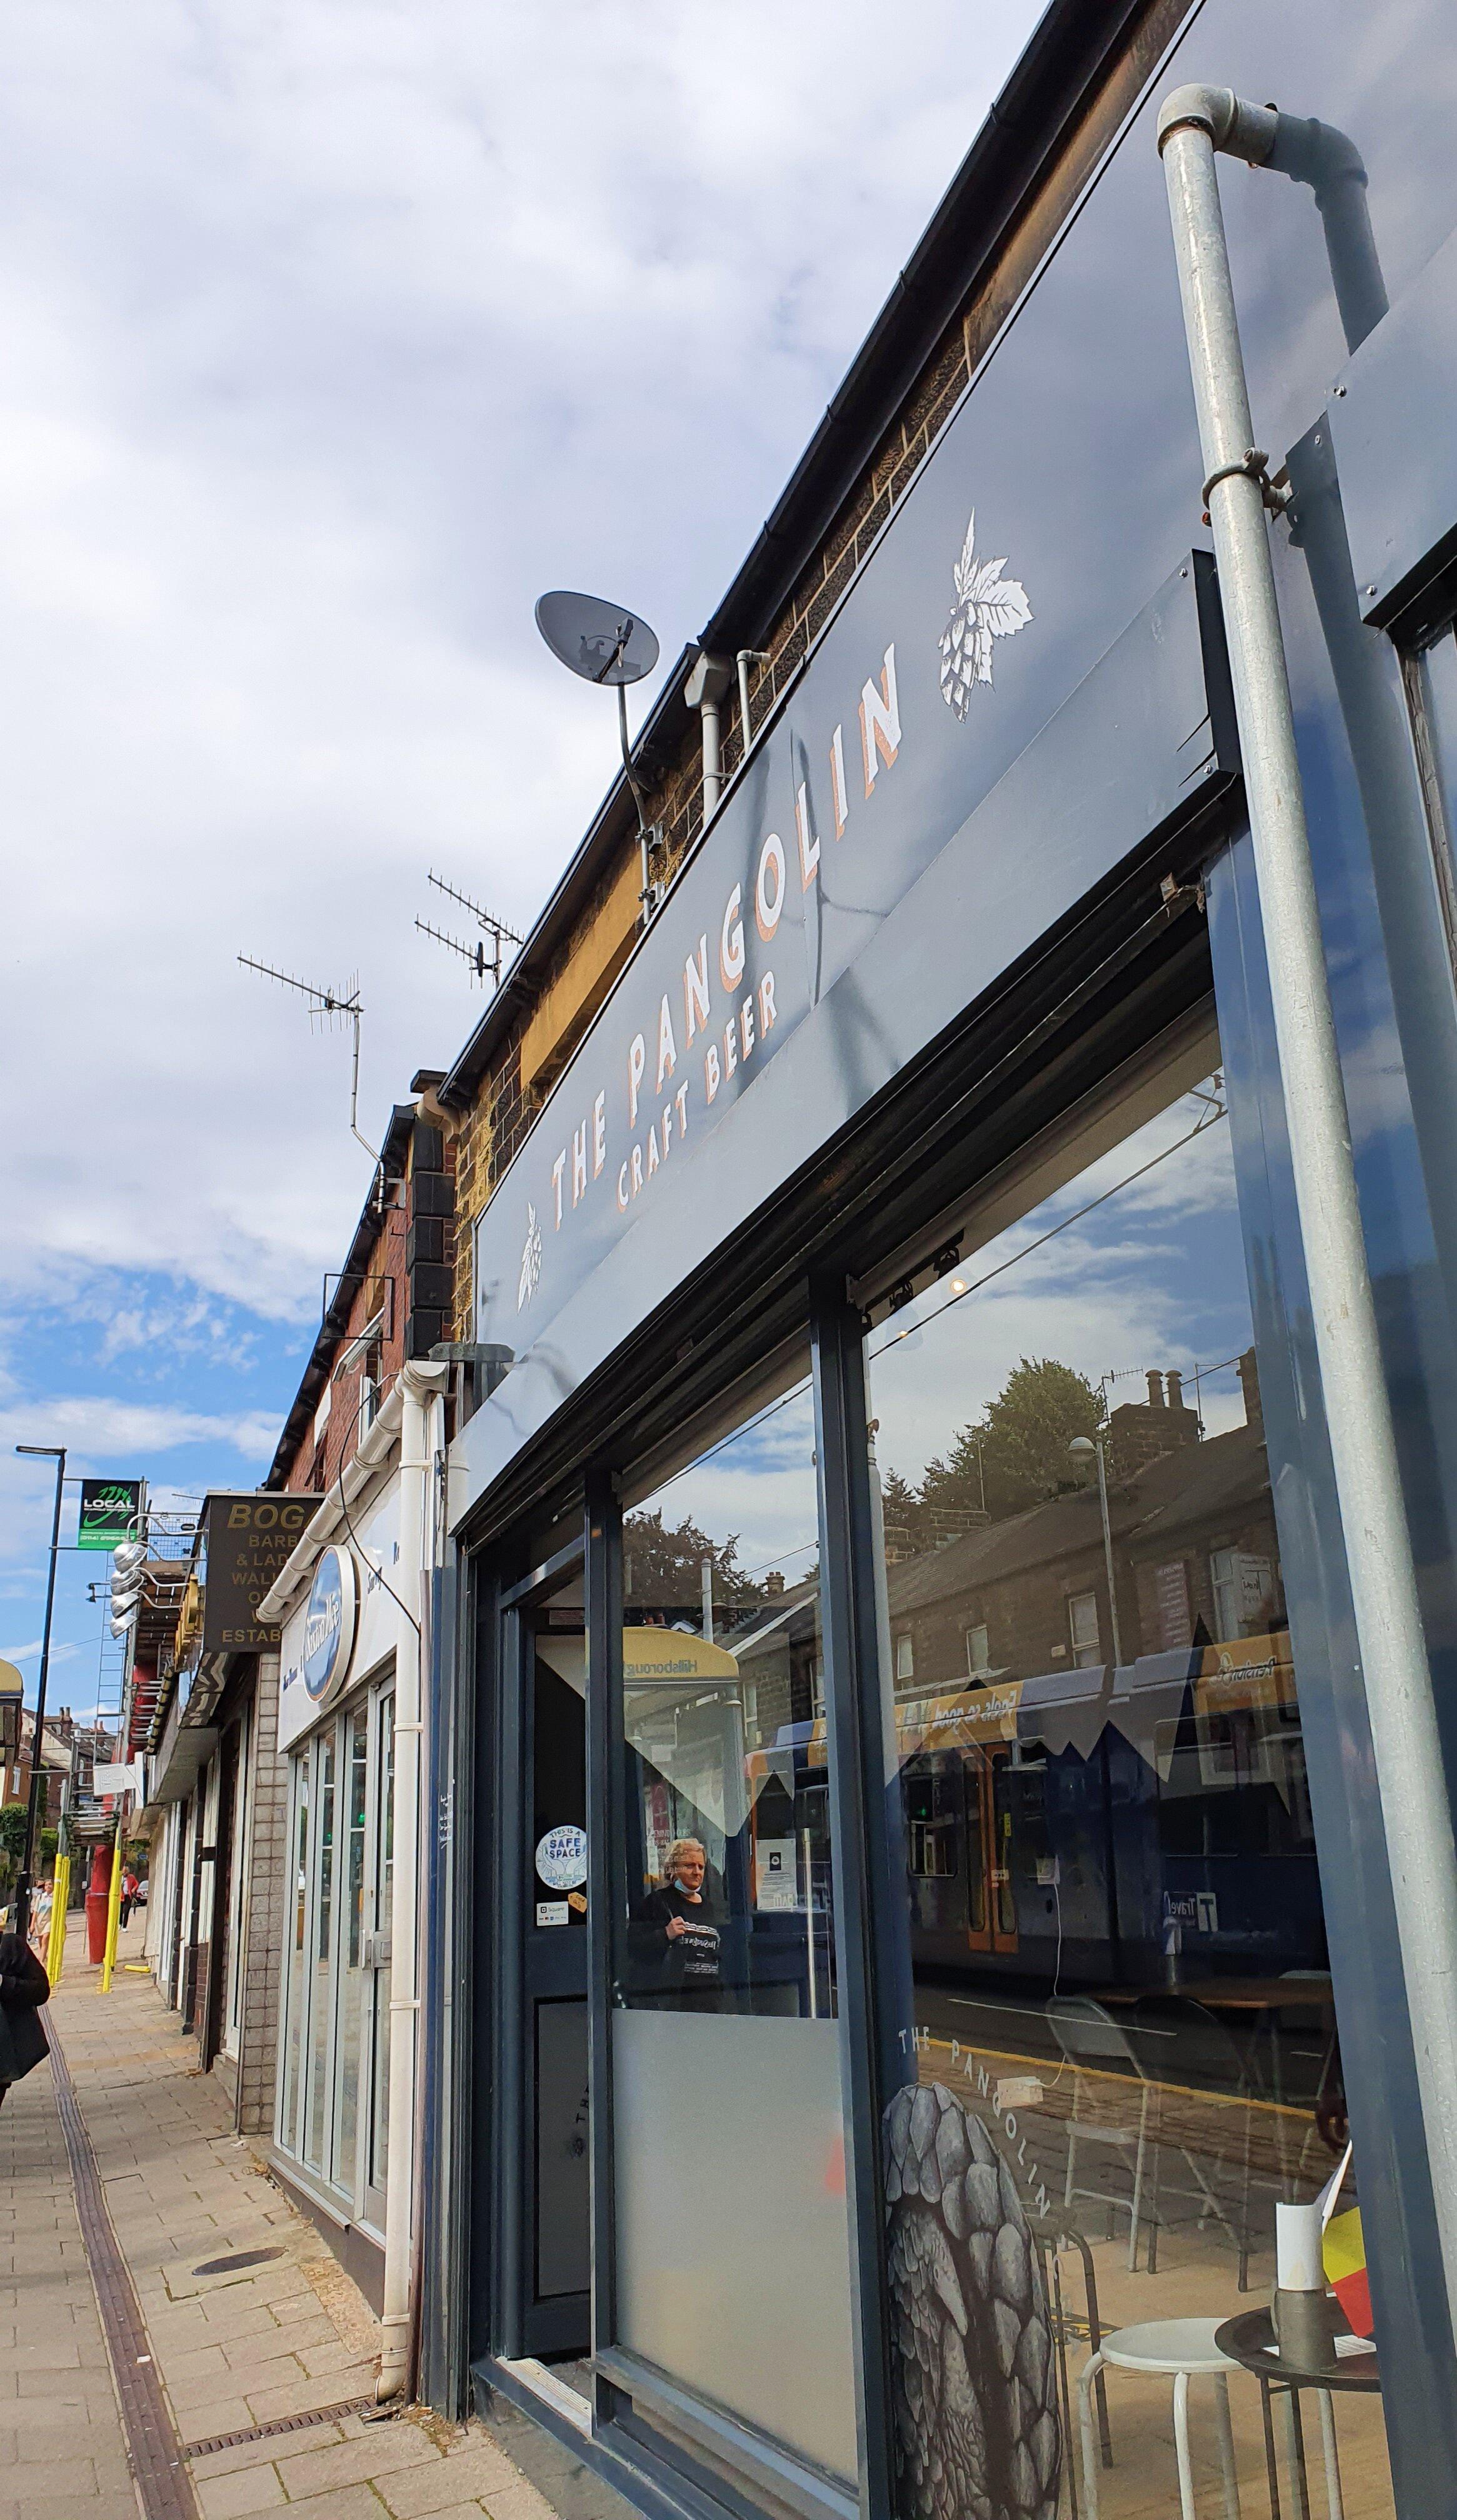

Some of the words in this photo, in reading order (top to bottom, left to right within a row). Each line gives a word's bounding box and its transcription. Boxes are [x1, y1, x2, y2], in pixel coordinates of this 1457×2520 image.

[552, 1089, 606, 1231] THE
[629, 642, 903, 1129] PANGOLIN
[618, 1079, 688, 1212] CRAFT
[705, 971, 777, 1105] BEER
[84, 1499, 136, 1508] LOCAL
[236, 1554, 247, 1566] &
[222, 1629, 281, 1642] ESTAB
[549, 1838, 581, 1849] SAFE
[549, 1848, 581, 1859] SPACE
[898, 2026, 929, 2054] THE
